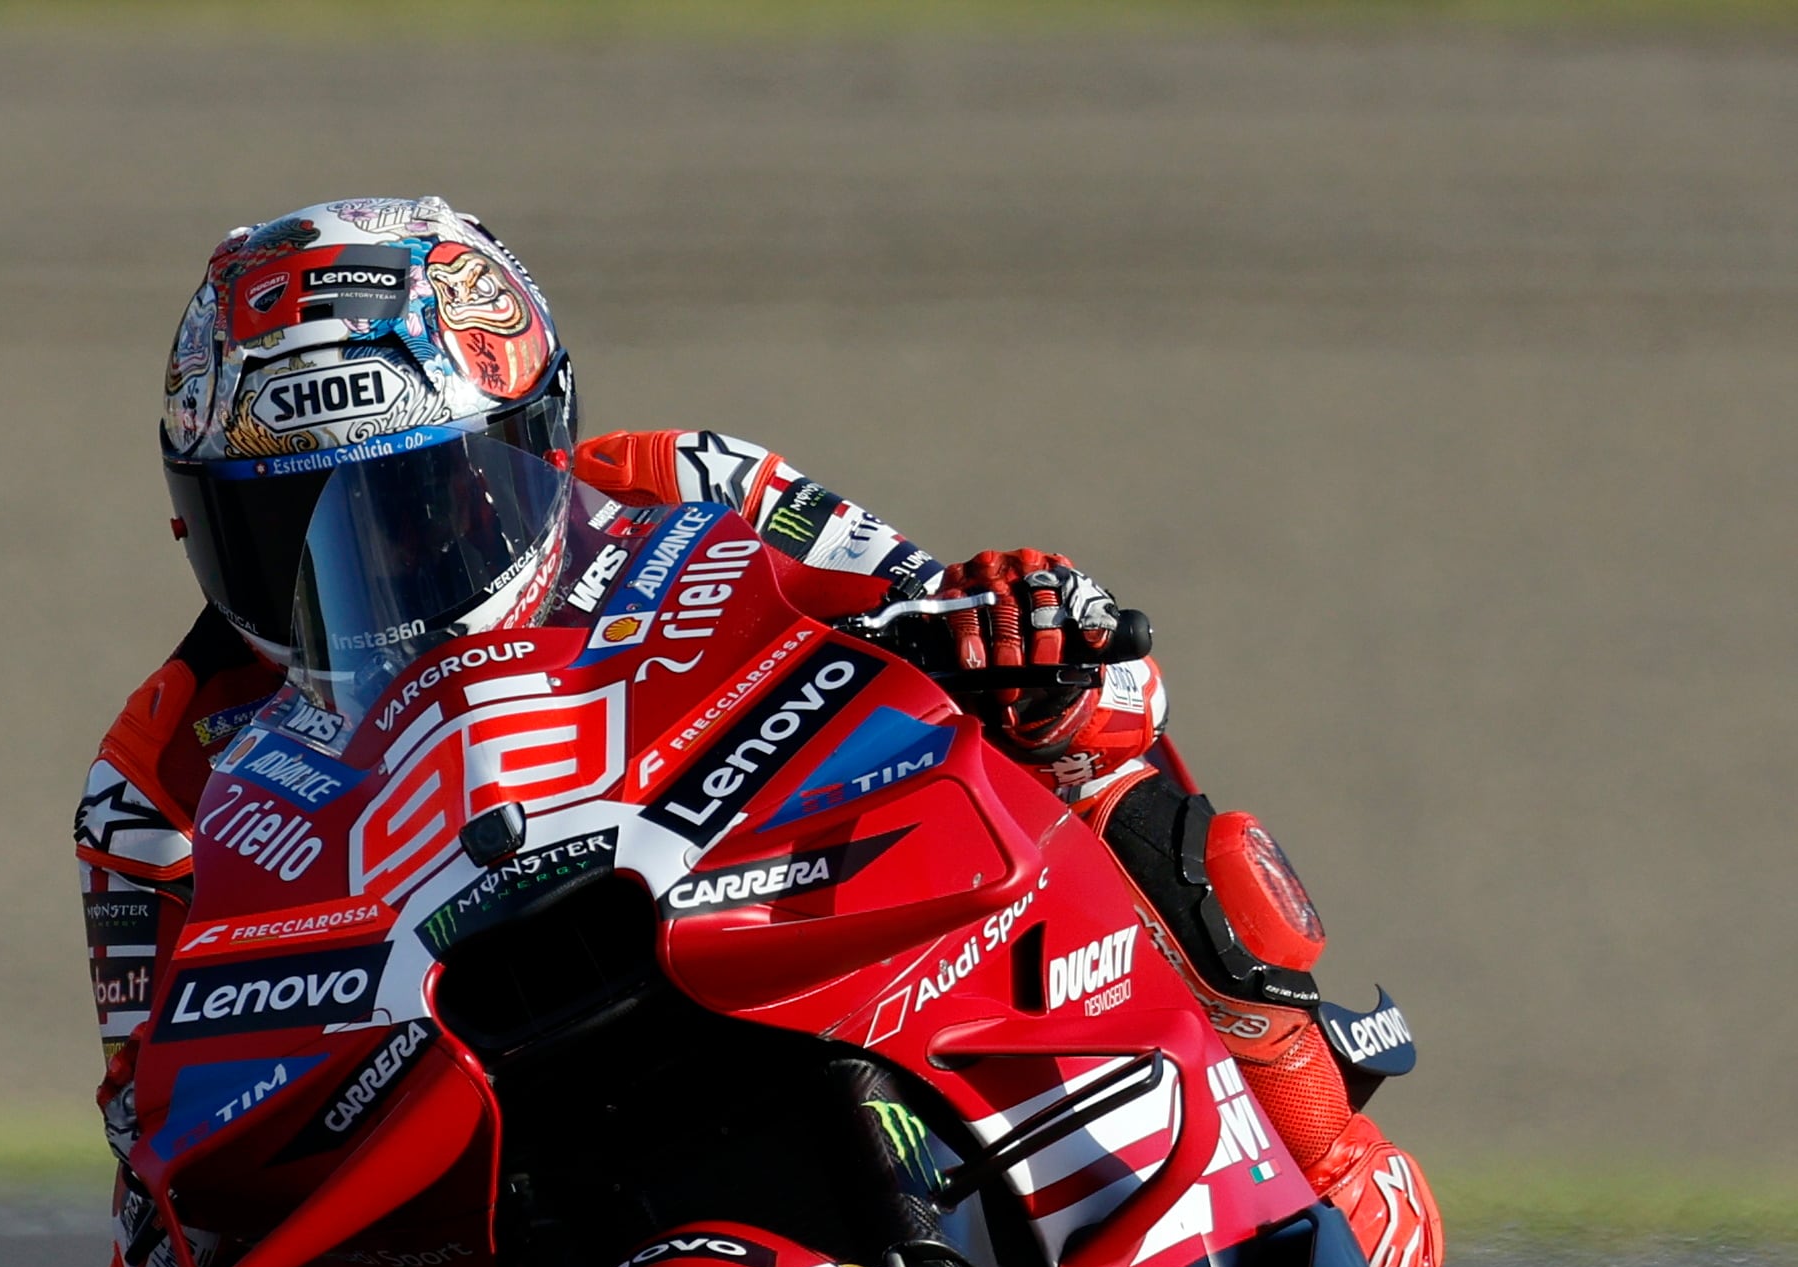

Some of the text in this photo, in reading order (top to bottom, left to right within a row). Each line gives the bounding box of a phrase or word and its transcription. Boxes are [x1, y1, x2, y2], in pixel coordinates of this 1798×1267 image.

[250, 275, 286, 295] DUCATI
[309, 271, 398, 287] Lenovo
[340, 291, 374, 300] FACTORY
[269, 369, 386, 423] SHOEI
[273, 453, 333, 476] Estrella
[334, 438, 395, 466] Galicia
[483, 544, 539, 595] VERTICAL
[566, 543, 630, 614] WRS
[635, 510, 715, 600] ADVANCE
[212, 599, 260, 636] VERTICAL
[659, 538, 762, 641] riello
[374, 640, 536, 733] VARGROUP
[669, 628, 815, 751] FRECCIAROSSA
[286, 702, 343, 743] WRS
[663, 659, 856, 827] Lenovo
[243, 748, 343, 805] ADVANCE
[851, 751, 935, 794] TIM
[216, 799, 325, 883] riello
[456, 834, 614, 913] MONSTER
[481, 860, 590, 912] ENERGY
[667, 856, 831, 910] CARRERA
[86, 902, 149, 920] MONSTER
[230, 903, 380, 940] FRECCIAROSSA
[913, 935, 982, 1013] Audi
[1048, 923, 1140, 1011] DUCATI
[170, 967, 370, 1025] Lenovo
[215, 1062, 289, 1123] TIM
[323, 1020, 430, 1134] CARRERA
